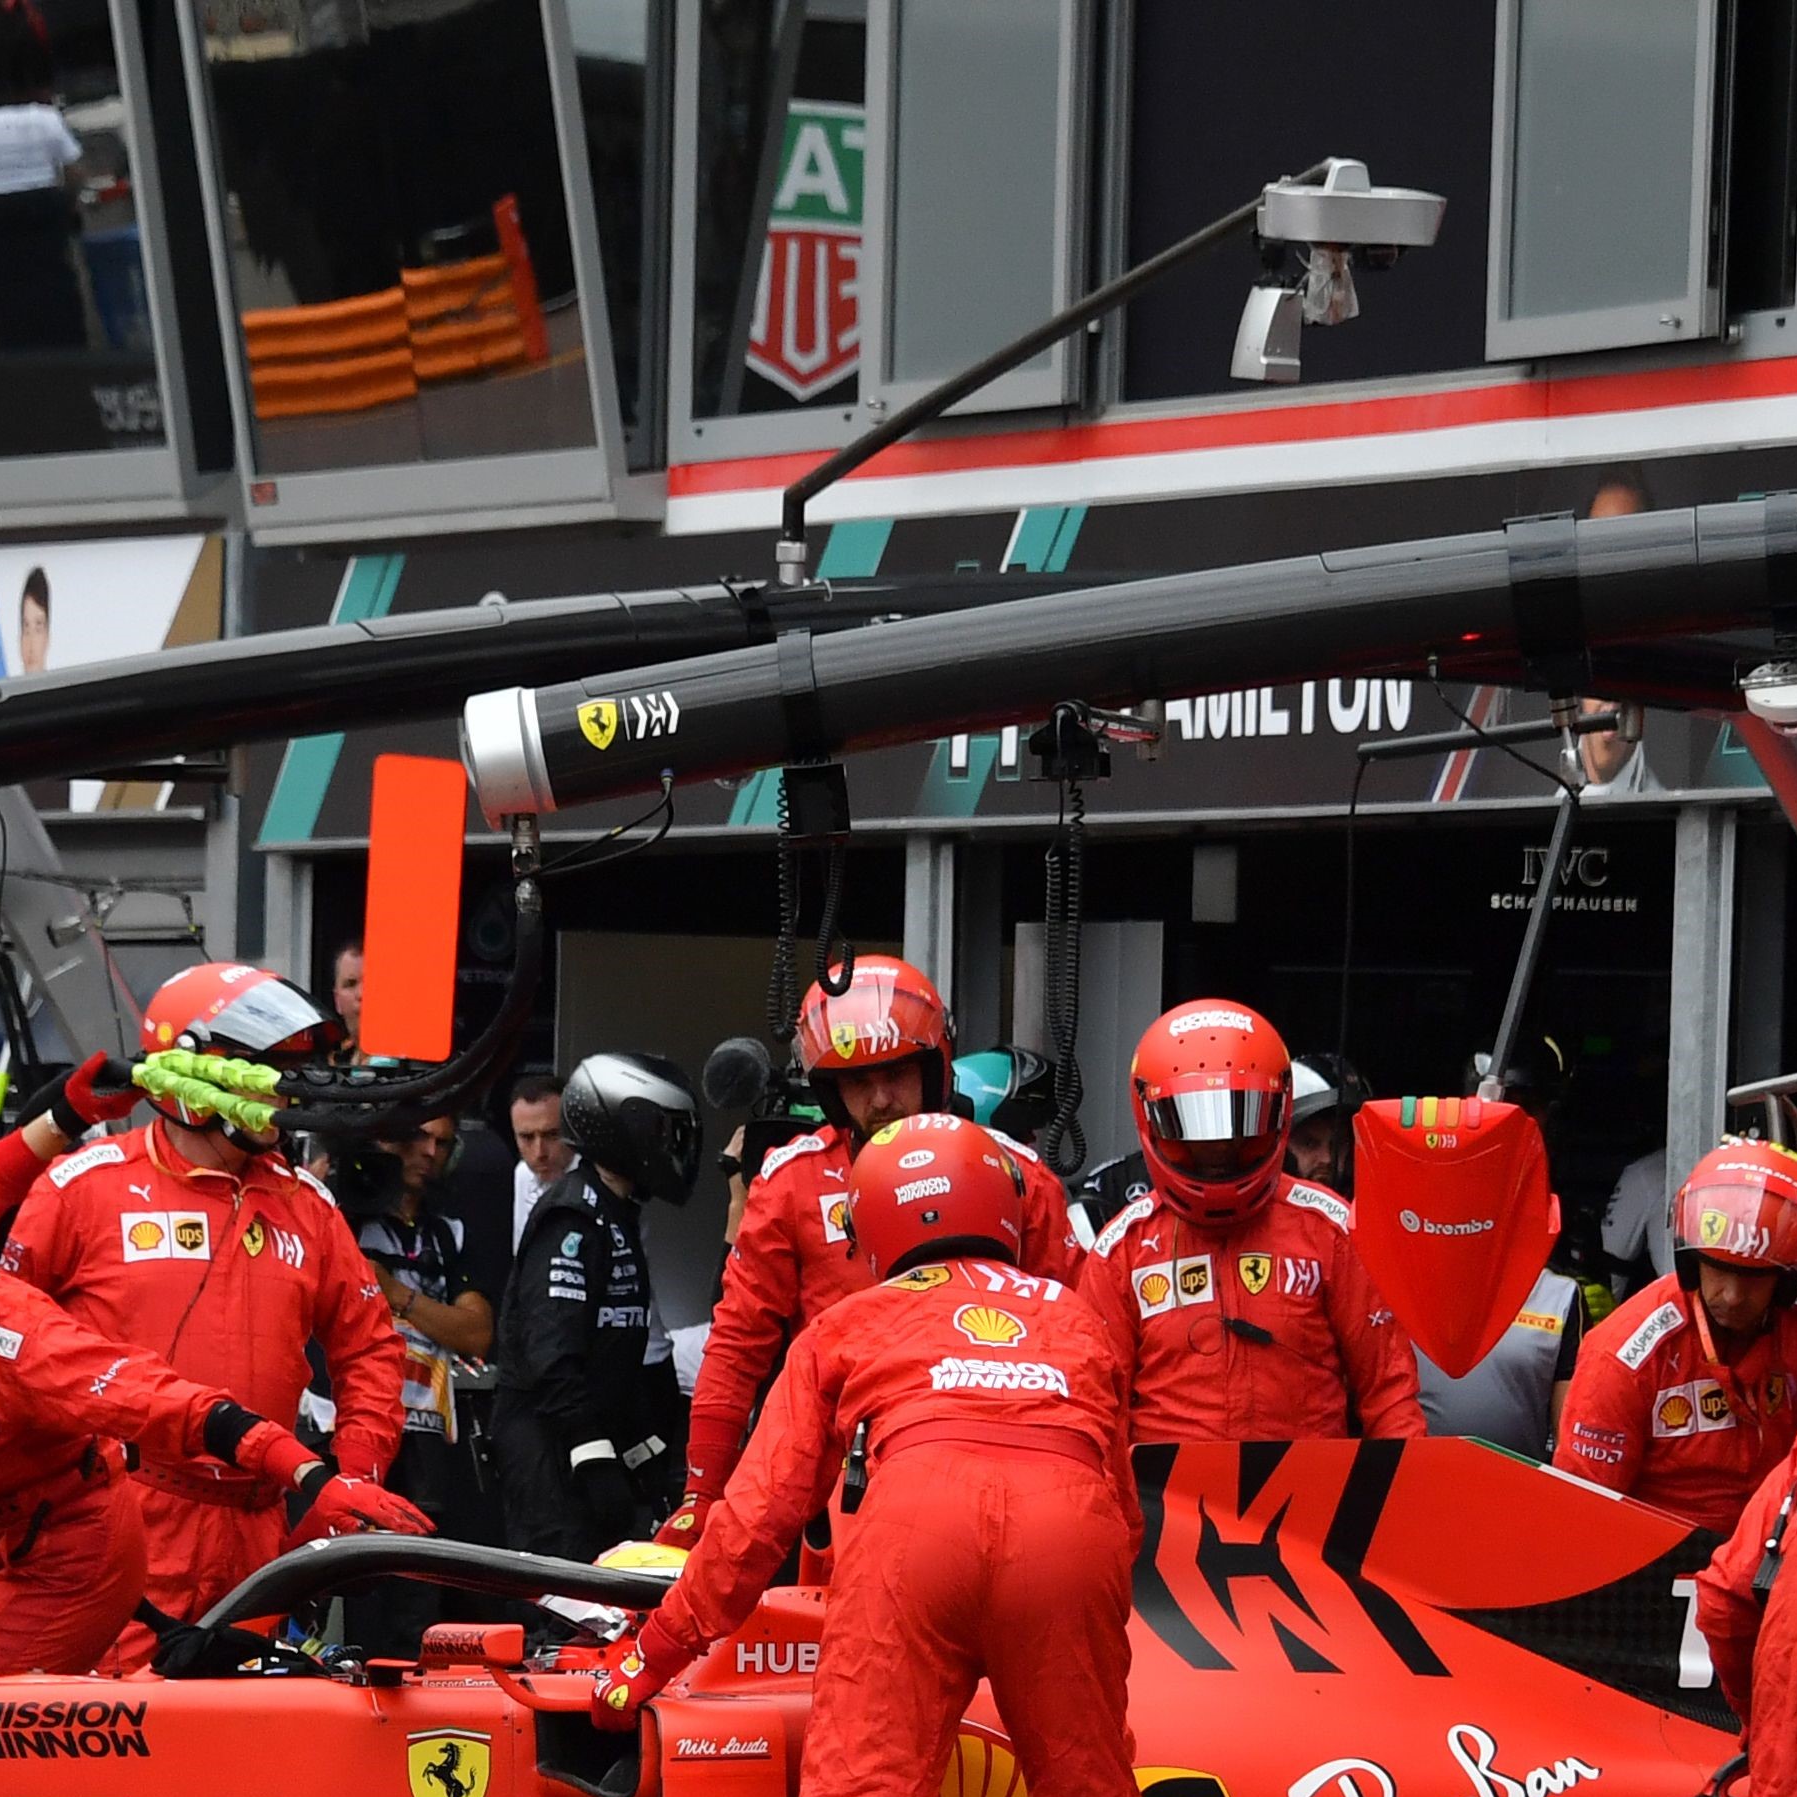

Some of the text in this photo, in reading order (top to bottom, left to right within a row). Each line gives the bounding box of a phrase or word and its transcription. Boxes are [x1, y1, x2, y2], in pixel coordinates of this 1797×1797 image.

[904, 1153, 930, 1166] BELL
[178, 1228, 203, 1249] ups
[1423, 1218, 1494, 1236] brembo
[1181, 1270, 1206, 1296] ups
[1622, 1309, 1671, 1364] KASPERSKY
[930, 1357, 1066, 1387] MISSION
[931, 1372, 1069, 1398] WINNOW
[1701, 1396, 1728, 1423] ups
[1572, 1440, 1607, 1460] AMD
[676, 1736, 769, 1756] Niki Lauda
